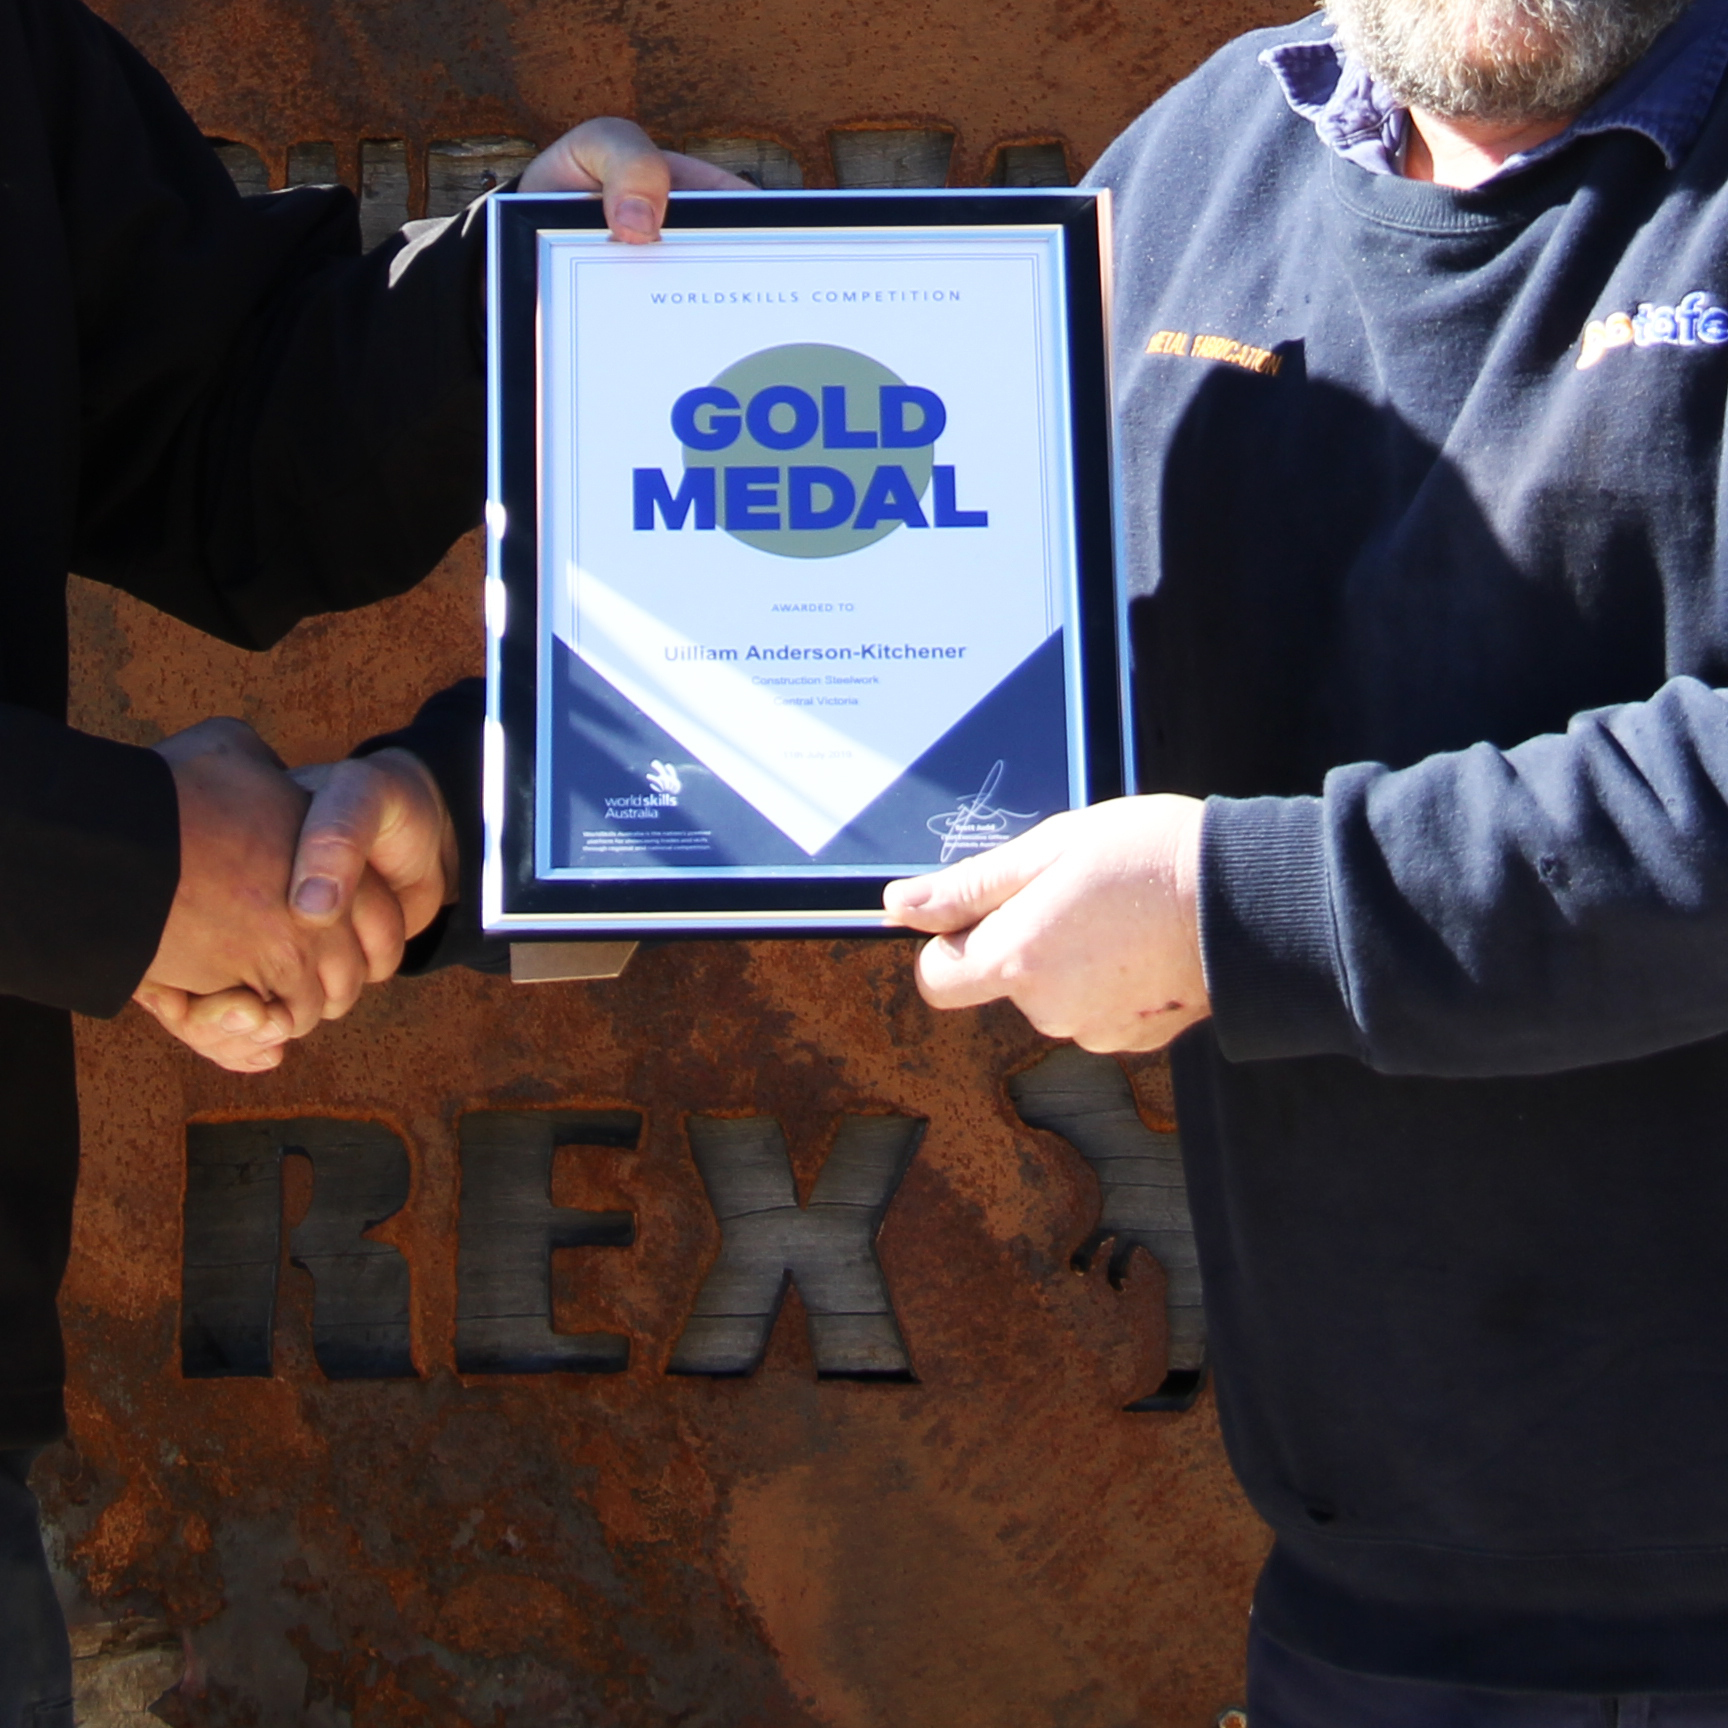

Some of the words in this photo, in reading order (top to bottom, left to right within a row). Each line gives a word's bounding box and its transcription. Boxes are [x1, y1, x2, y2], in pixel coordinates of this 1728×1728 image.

[650, 291, 799, 304] WORLDSKILLS
[812, 290, 962, 303] COMPETITION
[670, 384, 947, 451] GOLD
[632, 465, 989, 531] MEDAL
[771, 603, 833, 613] AWARDED
[838, 603, 855, 612] TO
[664, 644, 738, 661] Uilliam
[745, 642, 967, 661] Anderson-Kitchener
[752, 675, 821, 686] Construction
[824, 674, 879, 685] Steelwork
[773, 696, 813, 706] Central
[817, 696, 859, 706] Victoria
[604, 807, 659, 819] Australia
[179, 1104, 930, 1384] REX
